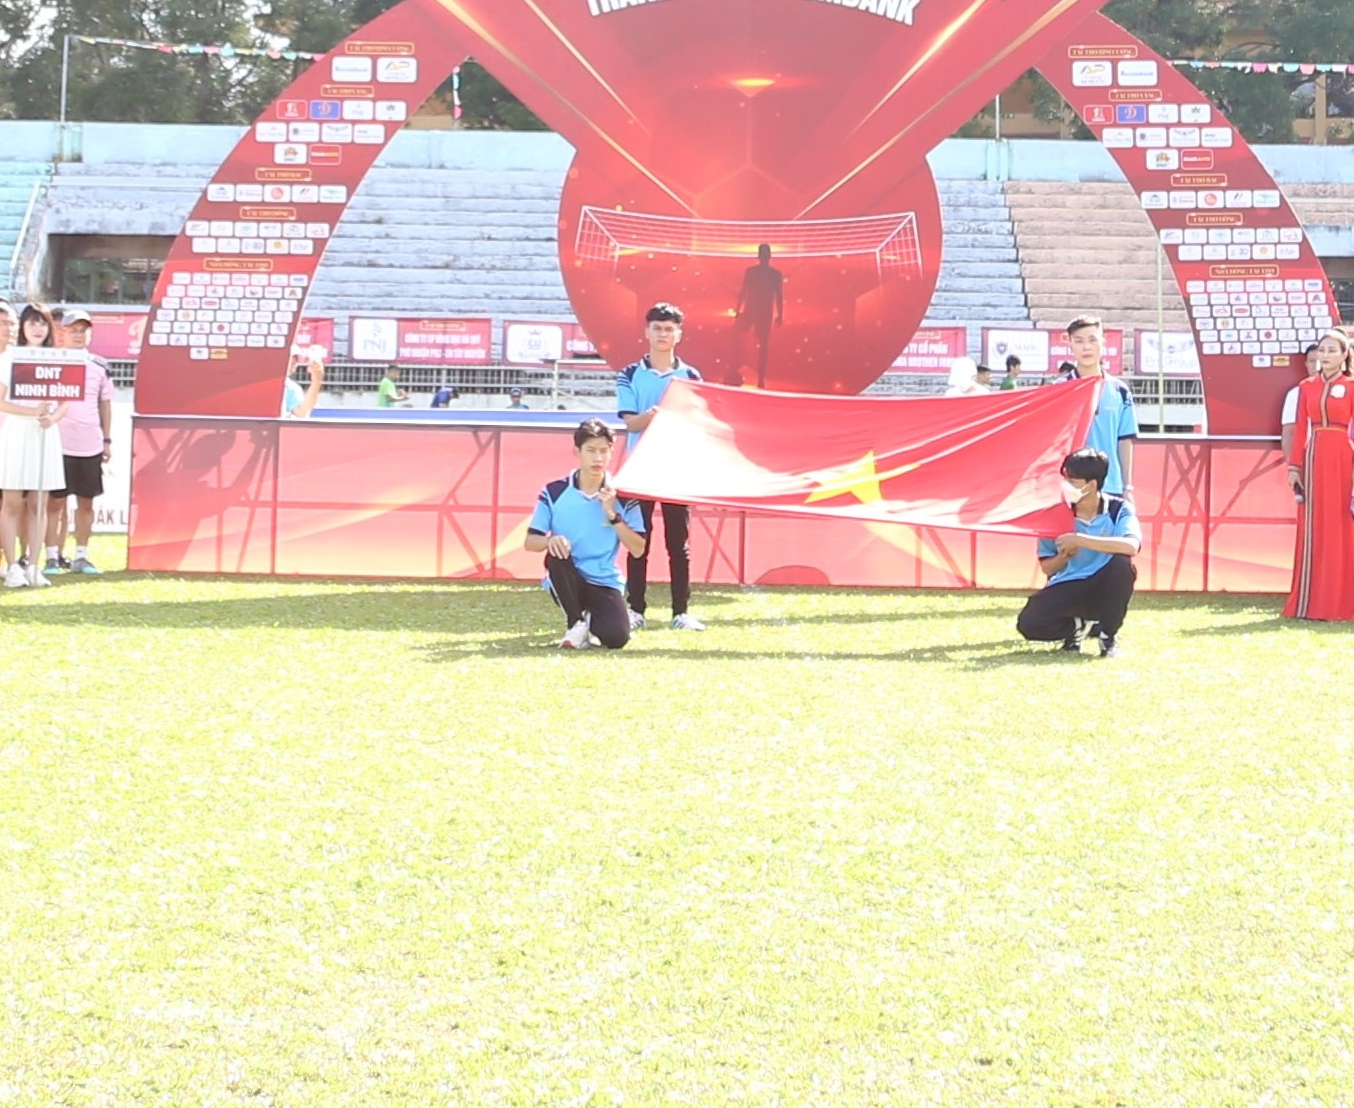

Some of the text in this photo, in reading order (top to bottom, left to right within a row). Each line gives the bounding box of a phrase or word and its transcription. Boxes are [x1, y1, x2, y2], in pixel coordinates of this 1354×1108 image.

[35, 367, 62, 379] DNT
[15, 382, 79, 397] NINH BÌNH
